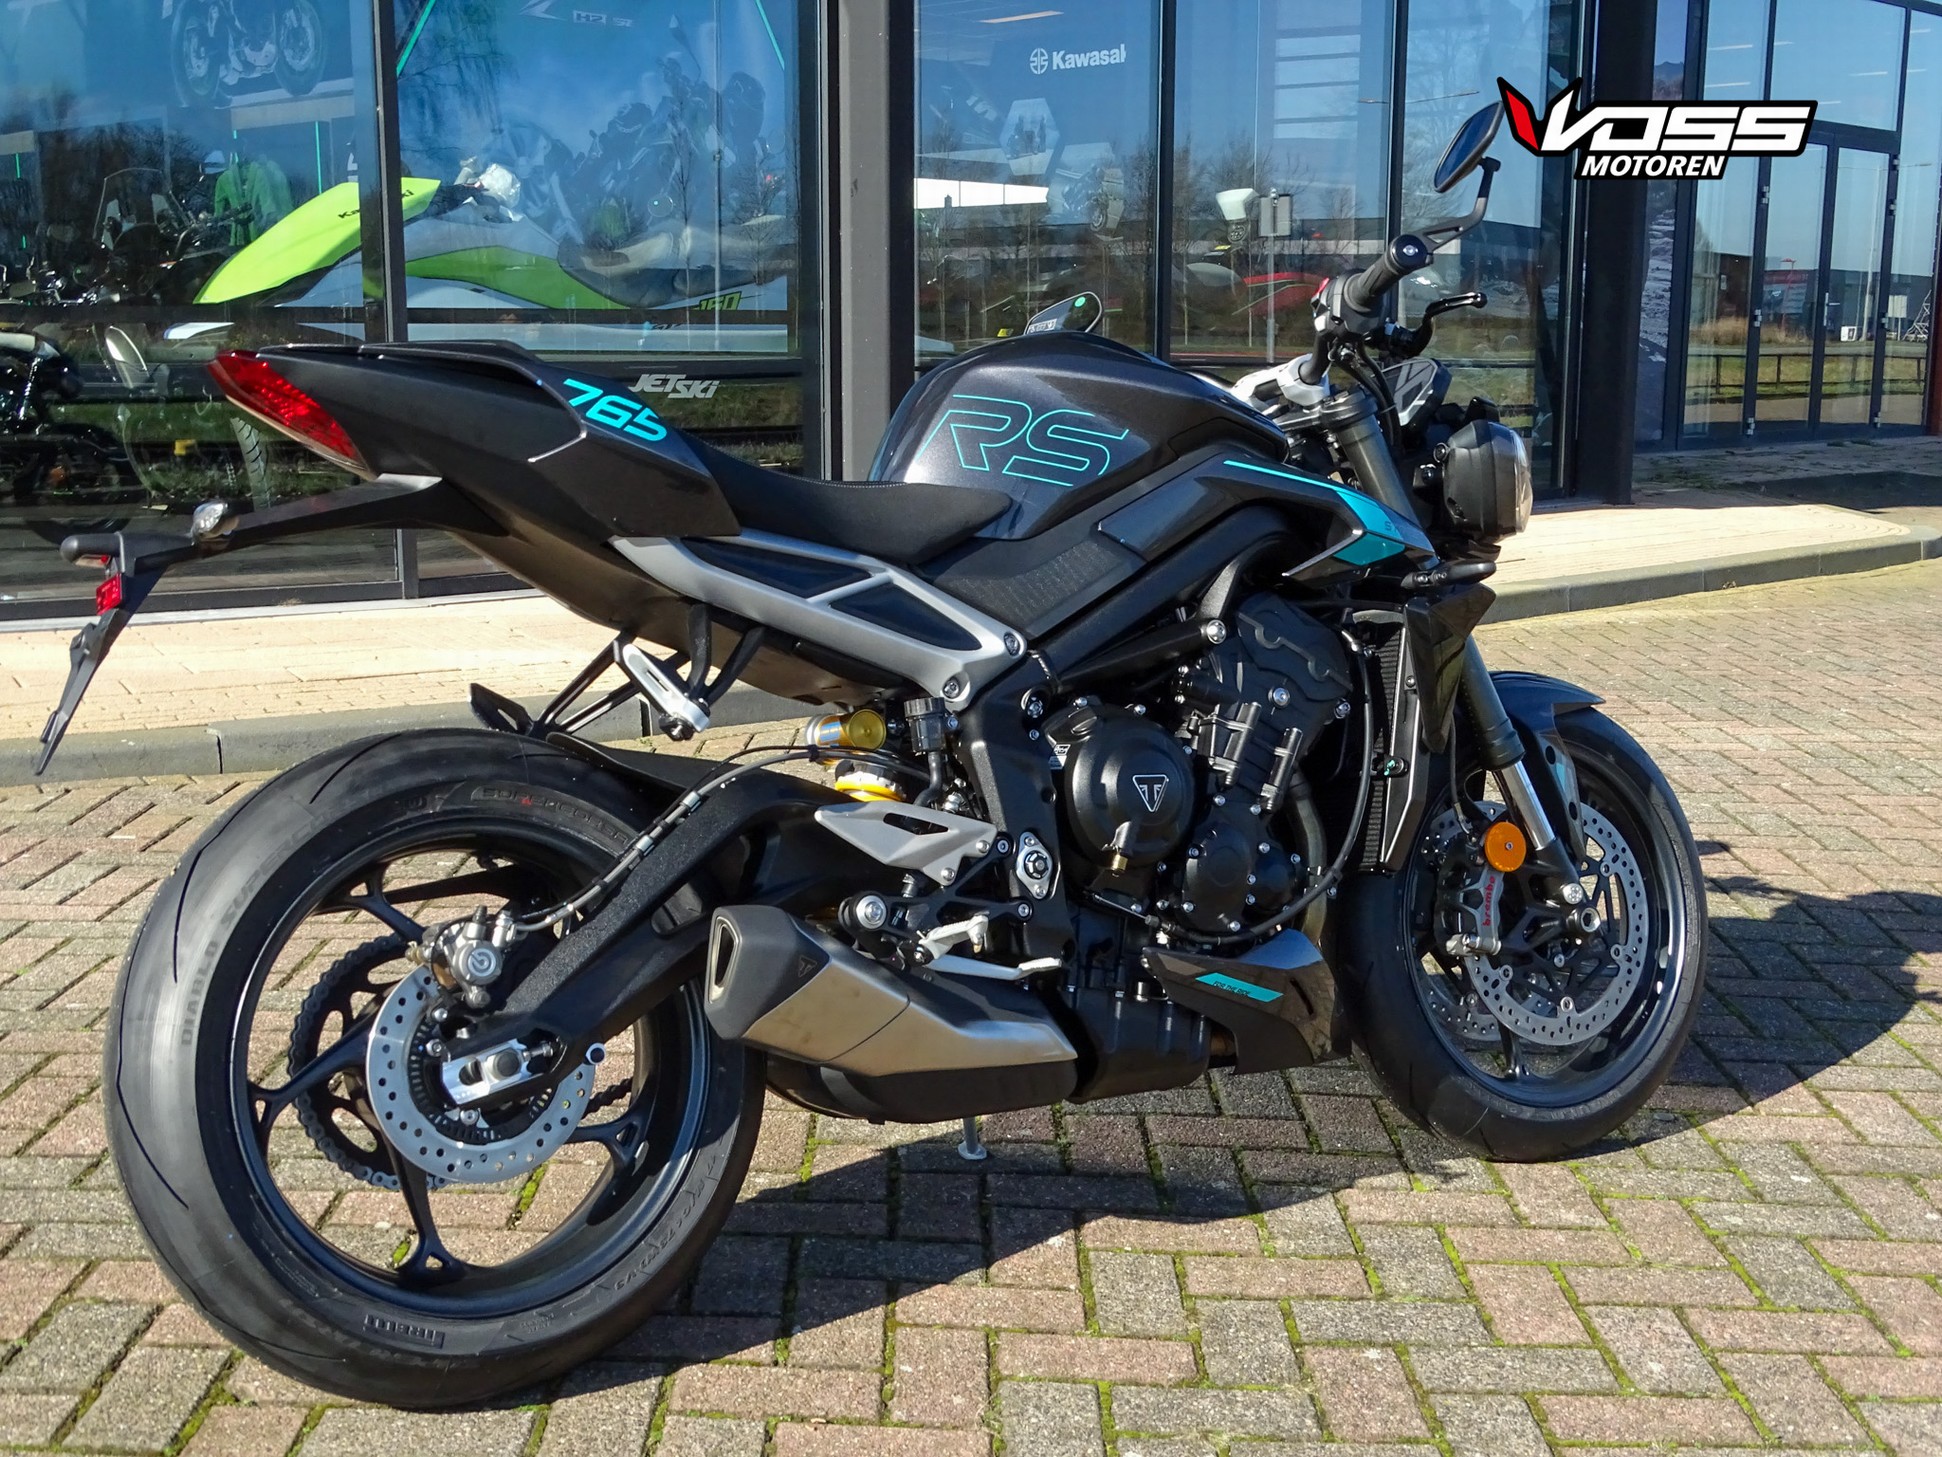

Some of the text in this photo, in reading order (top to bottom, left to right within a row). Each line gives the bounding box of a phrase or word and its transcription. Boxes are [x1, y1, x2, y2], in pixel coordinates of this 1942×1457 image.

[563, 378, 667, 442] 765
[915, 394, 1129, 487] RS
[1481, 875, 1496, 927] brembo
